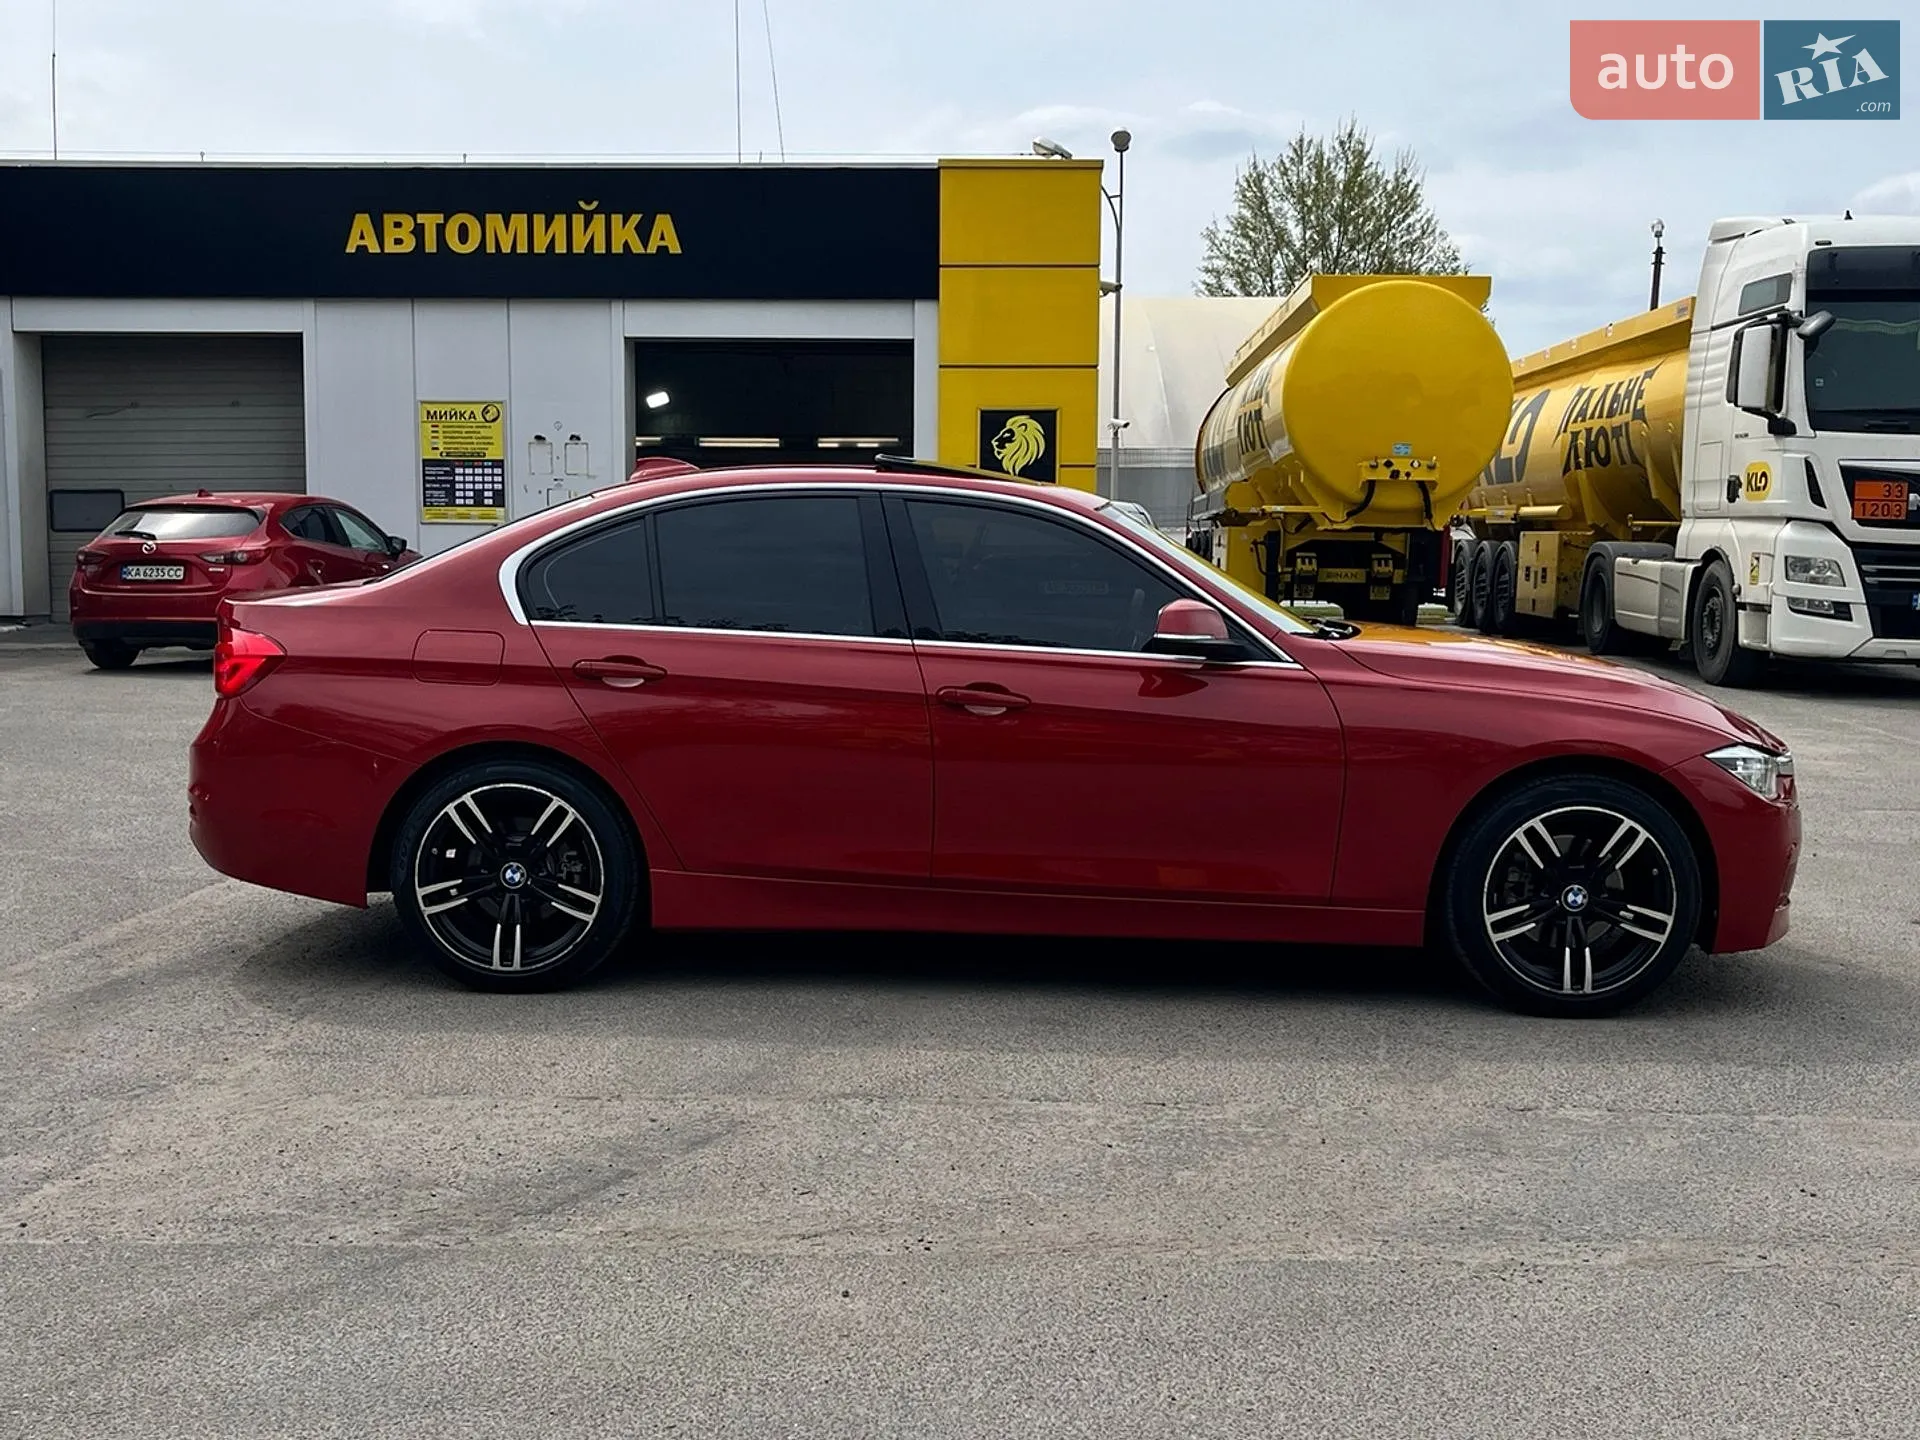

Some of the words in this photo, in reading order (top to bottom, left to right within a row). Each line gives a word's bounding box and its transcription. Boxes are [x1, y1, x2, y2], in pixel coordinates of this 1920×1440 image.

[345, 200, 682, 254] АВТОМИЙКА
[1555, 361, 1661, 441] ПАЛЬНЕ
[426, 407, 477, 420] МИЙКА
[1476, 389, 1551, 486] LO
[1562, 421, 1648, 477] ЛЮТІ
[1746, 471, 1768, 493] KLO
[1882, 483, 1904, 499] 33
[1860, 502, 1902, 517] 1203
[127, 567, 141, 578] KA
[143, 567, 166, 578] 6235
[167, 567, 182, 578] CC
